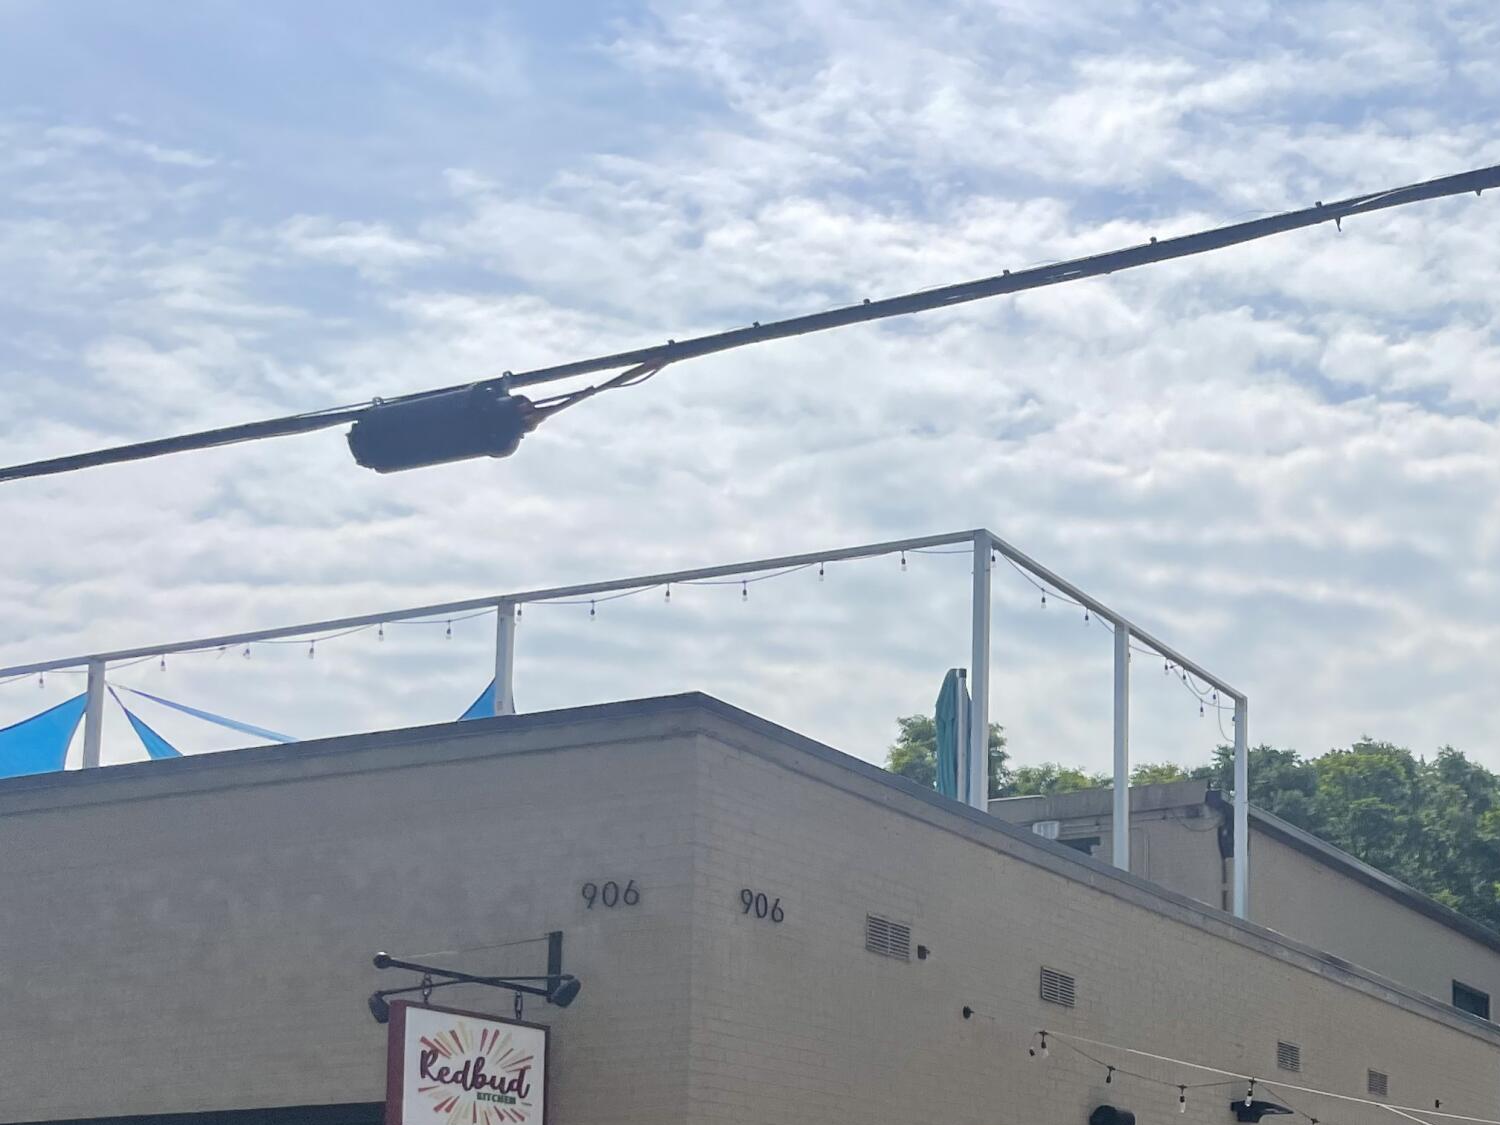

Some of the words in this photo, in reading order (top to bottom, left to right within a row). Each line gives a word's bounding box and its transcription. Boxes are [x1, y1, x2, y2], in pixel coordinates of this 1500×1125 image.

[581, 879, 640, 909] 906
[740, 888, 785, 924] 906
[420, 1048, 531, 1099] Redbud
